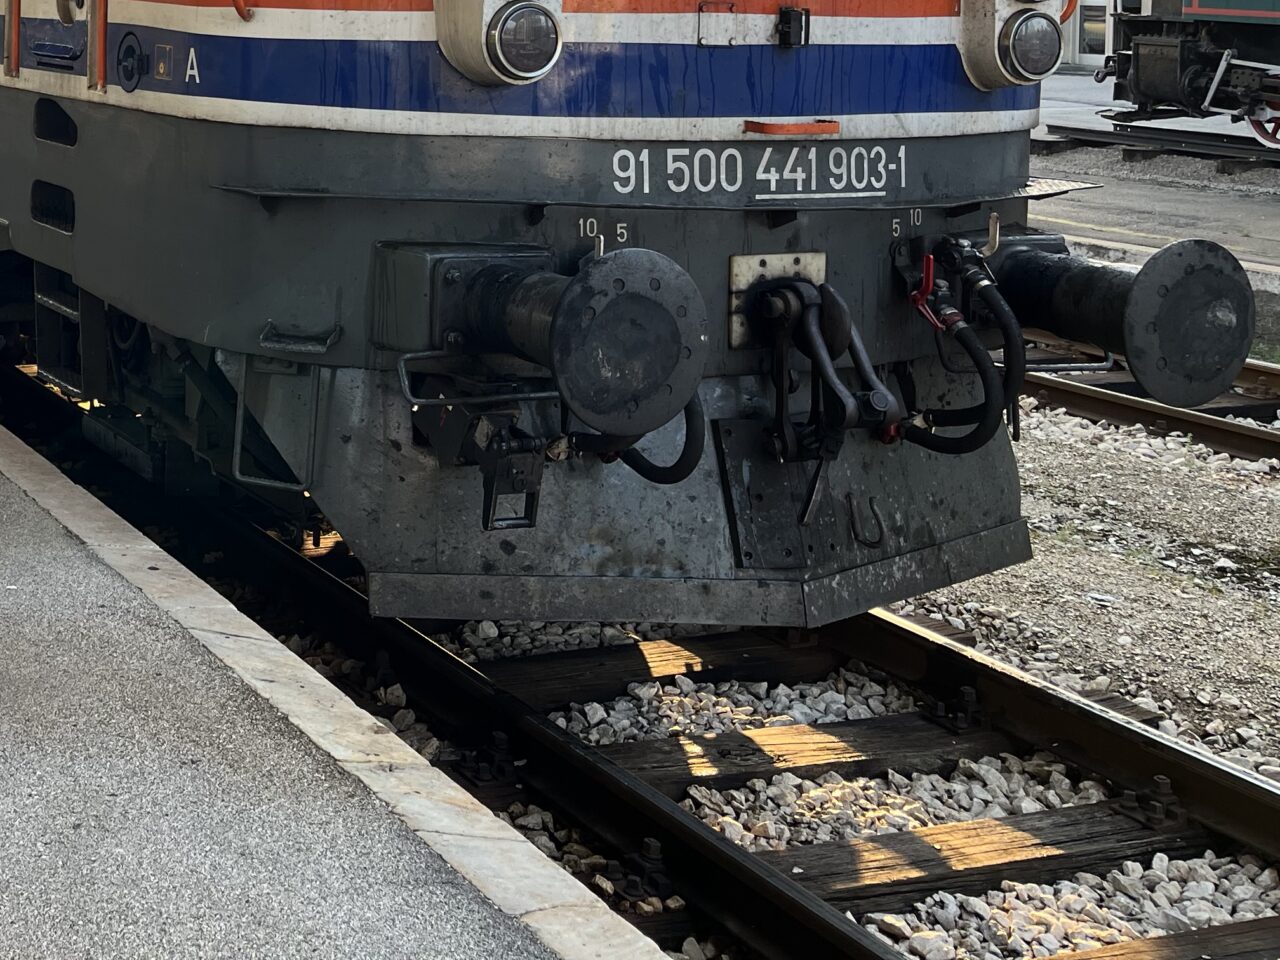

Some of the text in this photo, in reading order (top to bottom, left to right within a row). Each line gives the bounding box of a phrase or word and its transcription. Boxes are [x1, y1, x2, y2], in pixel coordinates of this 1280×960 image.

[185, 47, 200, 84] A
[612, 145, 906, 194] 91 500 441 903-1
[578, 217, 628, 243] 10 5
[892, 208, 922, 237] 5 10
